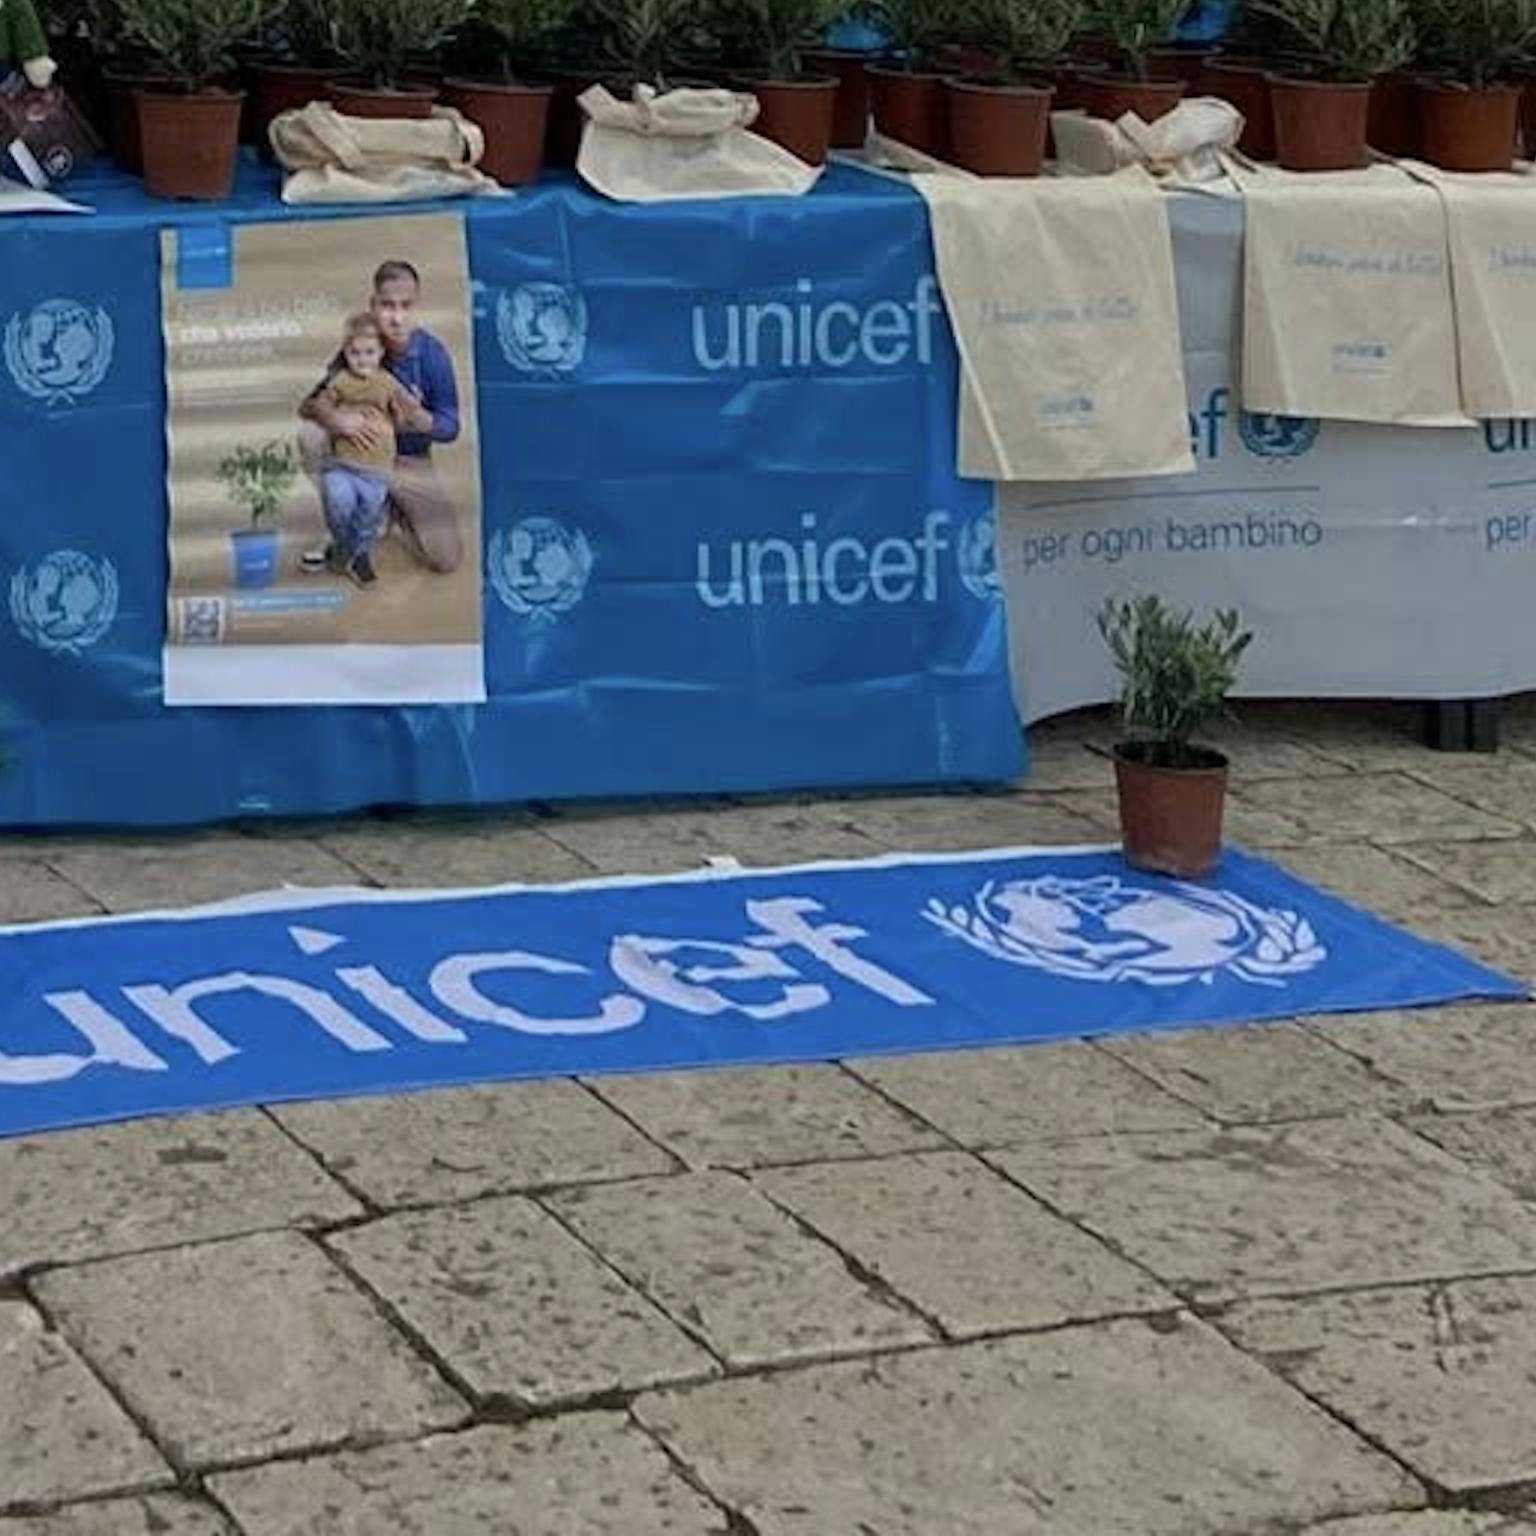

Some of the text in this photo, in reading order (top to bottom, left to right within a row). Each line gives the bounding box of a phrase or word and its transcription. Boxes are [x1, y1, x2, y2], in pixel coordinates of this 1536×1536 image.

[692, 278, 941, 370] unicef
[696, 512, 948, 608] unicef
[1023, 512, 1323, 566] per ogni bambino
[1487, 513, 1532, 551] per
